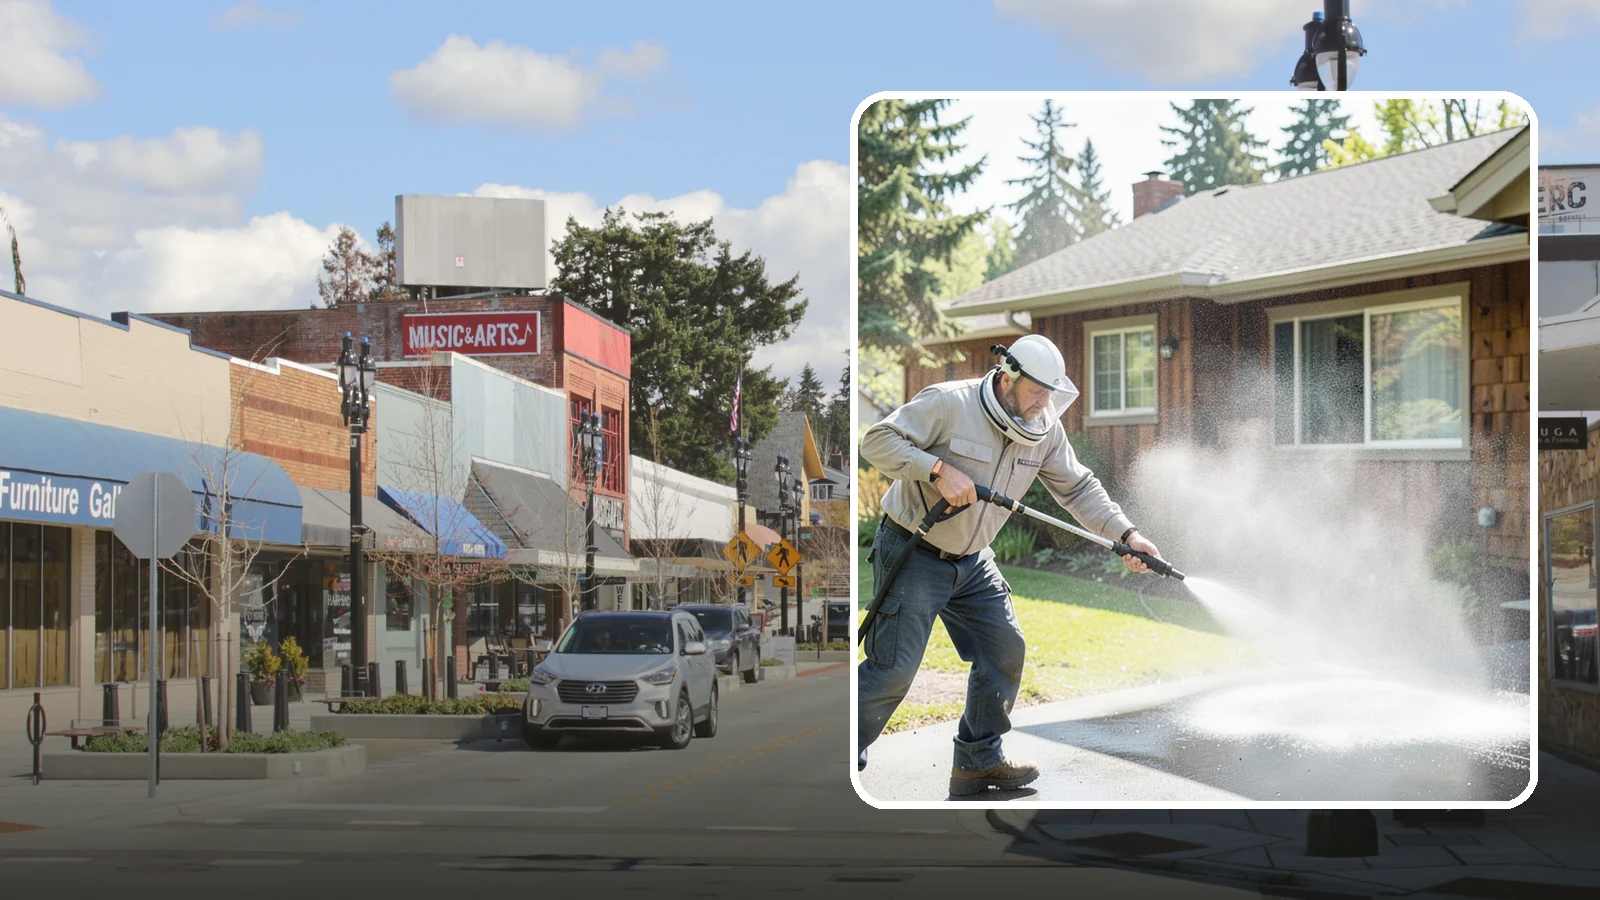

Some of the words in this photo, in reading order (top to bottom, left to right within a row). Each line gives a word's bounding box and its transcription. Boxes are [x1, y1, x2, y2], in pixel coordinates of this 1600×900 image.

[1540, 427, 1577, 436] UGA
[0, 471, 79, 515] Furniture
[89, 482, 122, 519] Gal
[453, 563, 479, 575] SUSHI
